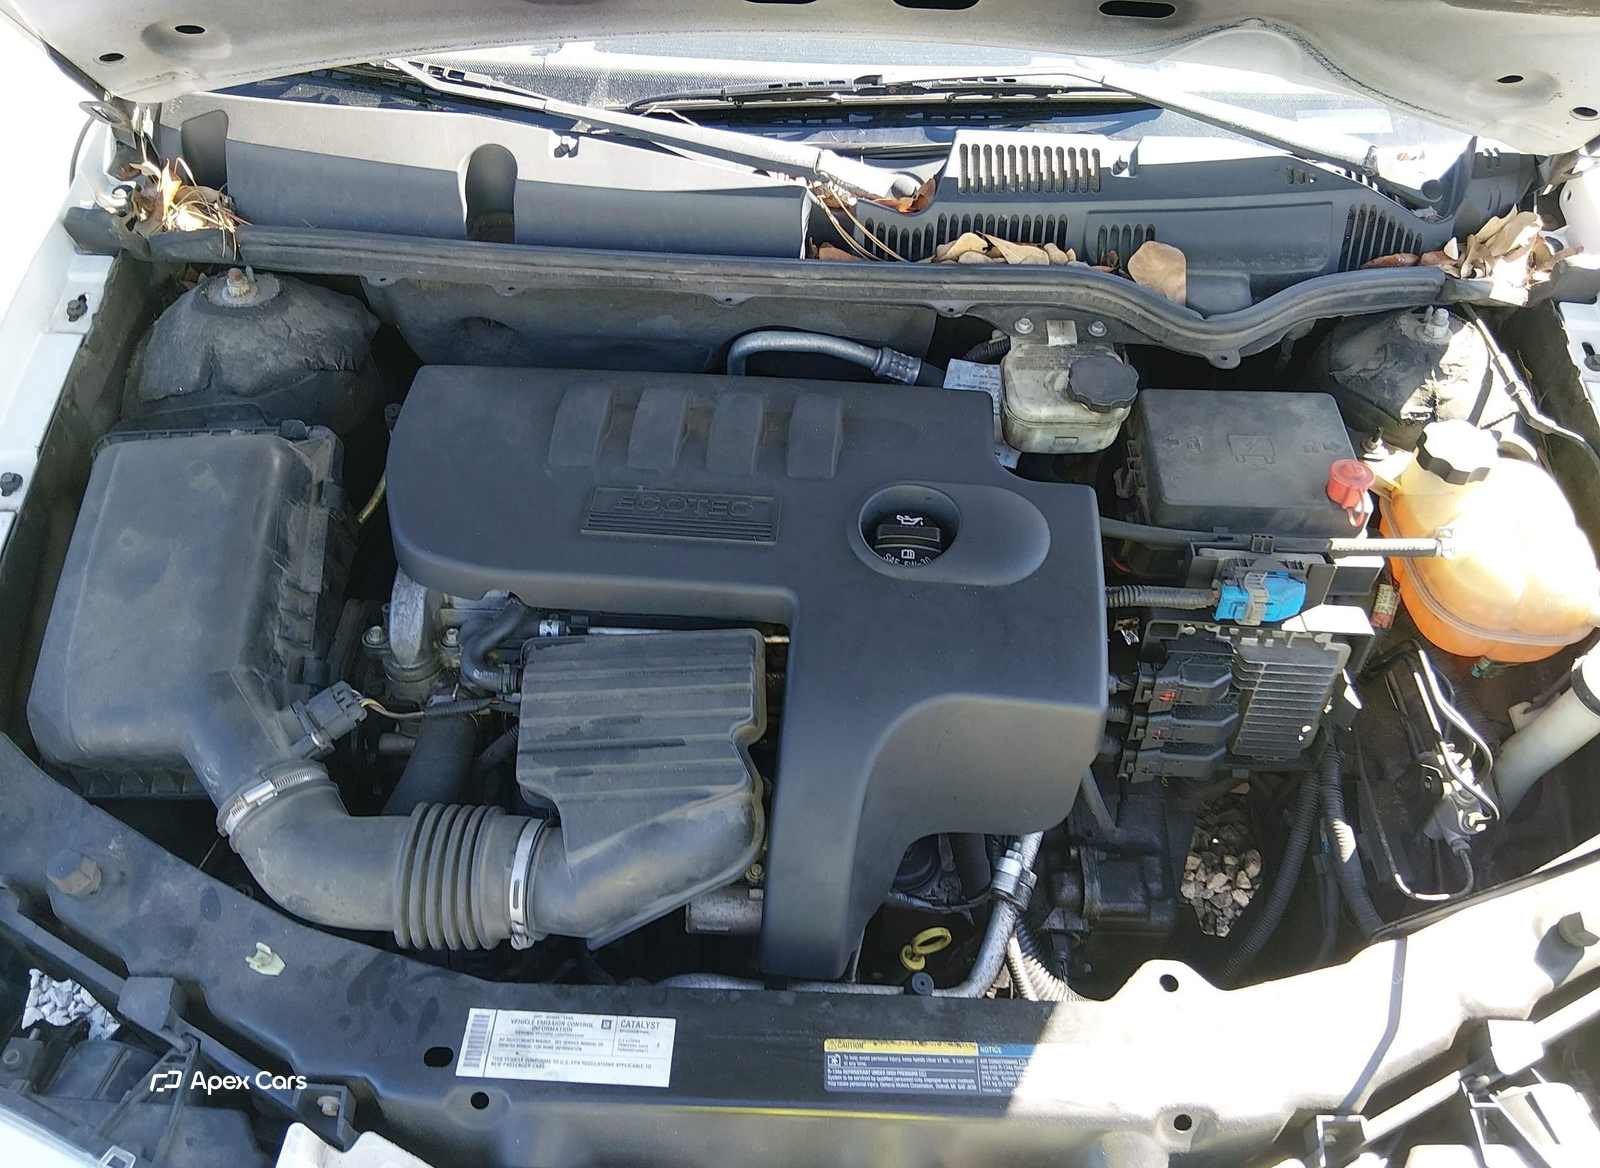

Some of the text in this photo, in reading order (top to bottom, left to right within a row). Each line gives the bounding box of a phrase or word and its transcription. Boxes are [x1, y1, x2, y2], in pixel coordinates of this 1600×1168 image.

[614, 493, 754, 517] ECOTEC
[531, 1025, 573, 1033] INFORMATION
[620, 1020, 661, 1030] CATALYST
[838, 1041, 864, 1049] CAUTION
[980, 1046, 1002, 1054] NOTICE
